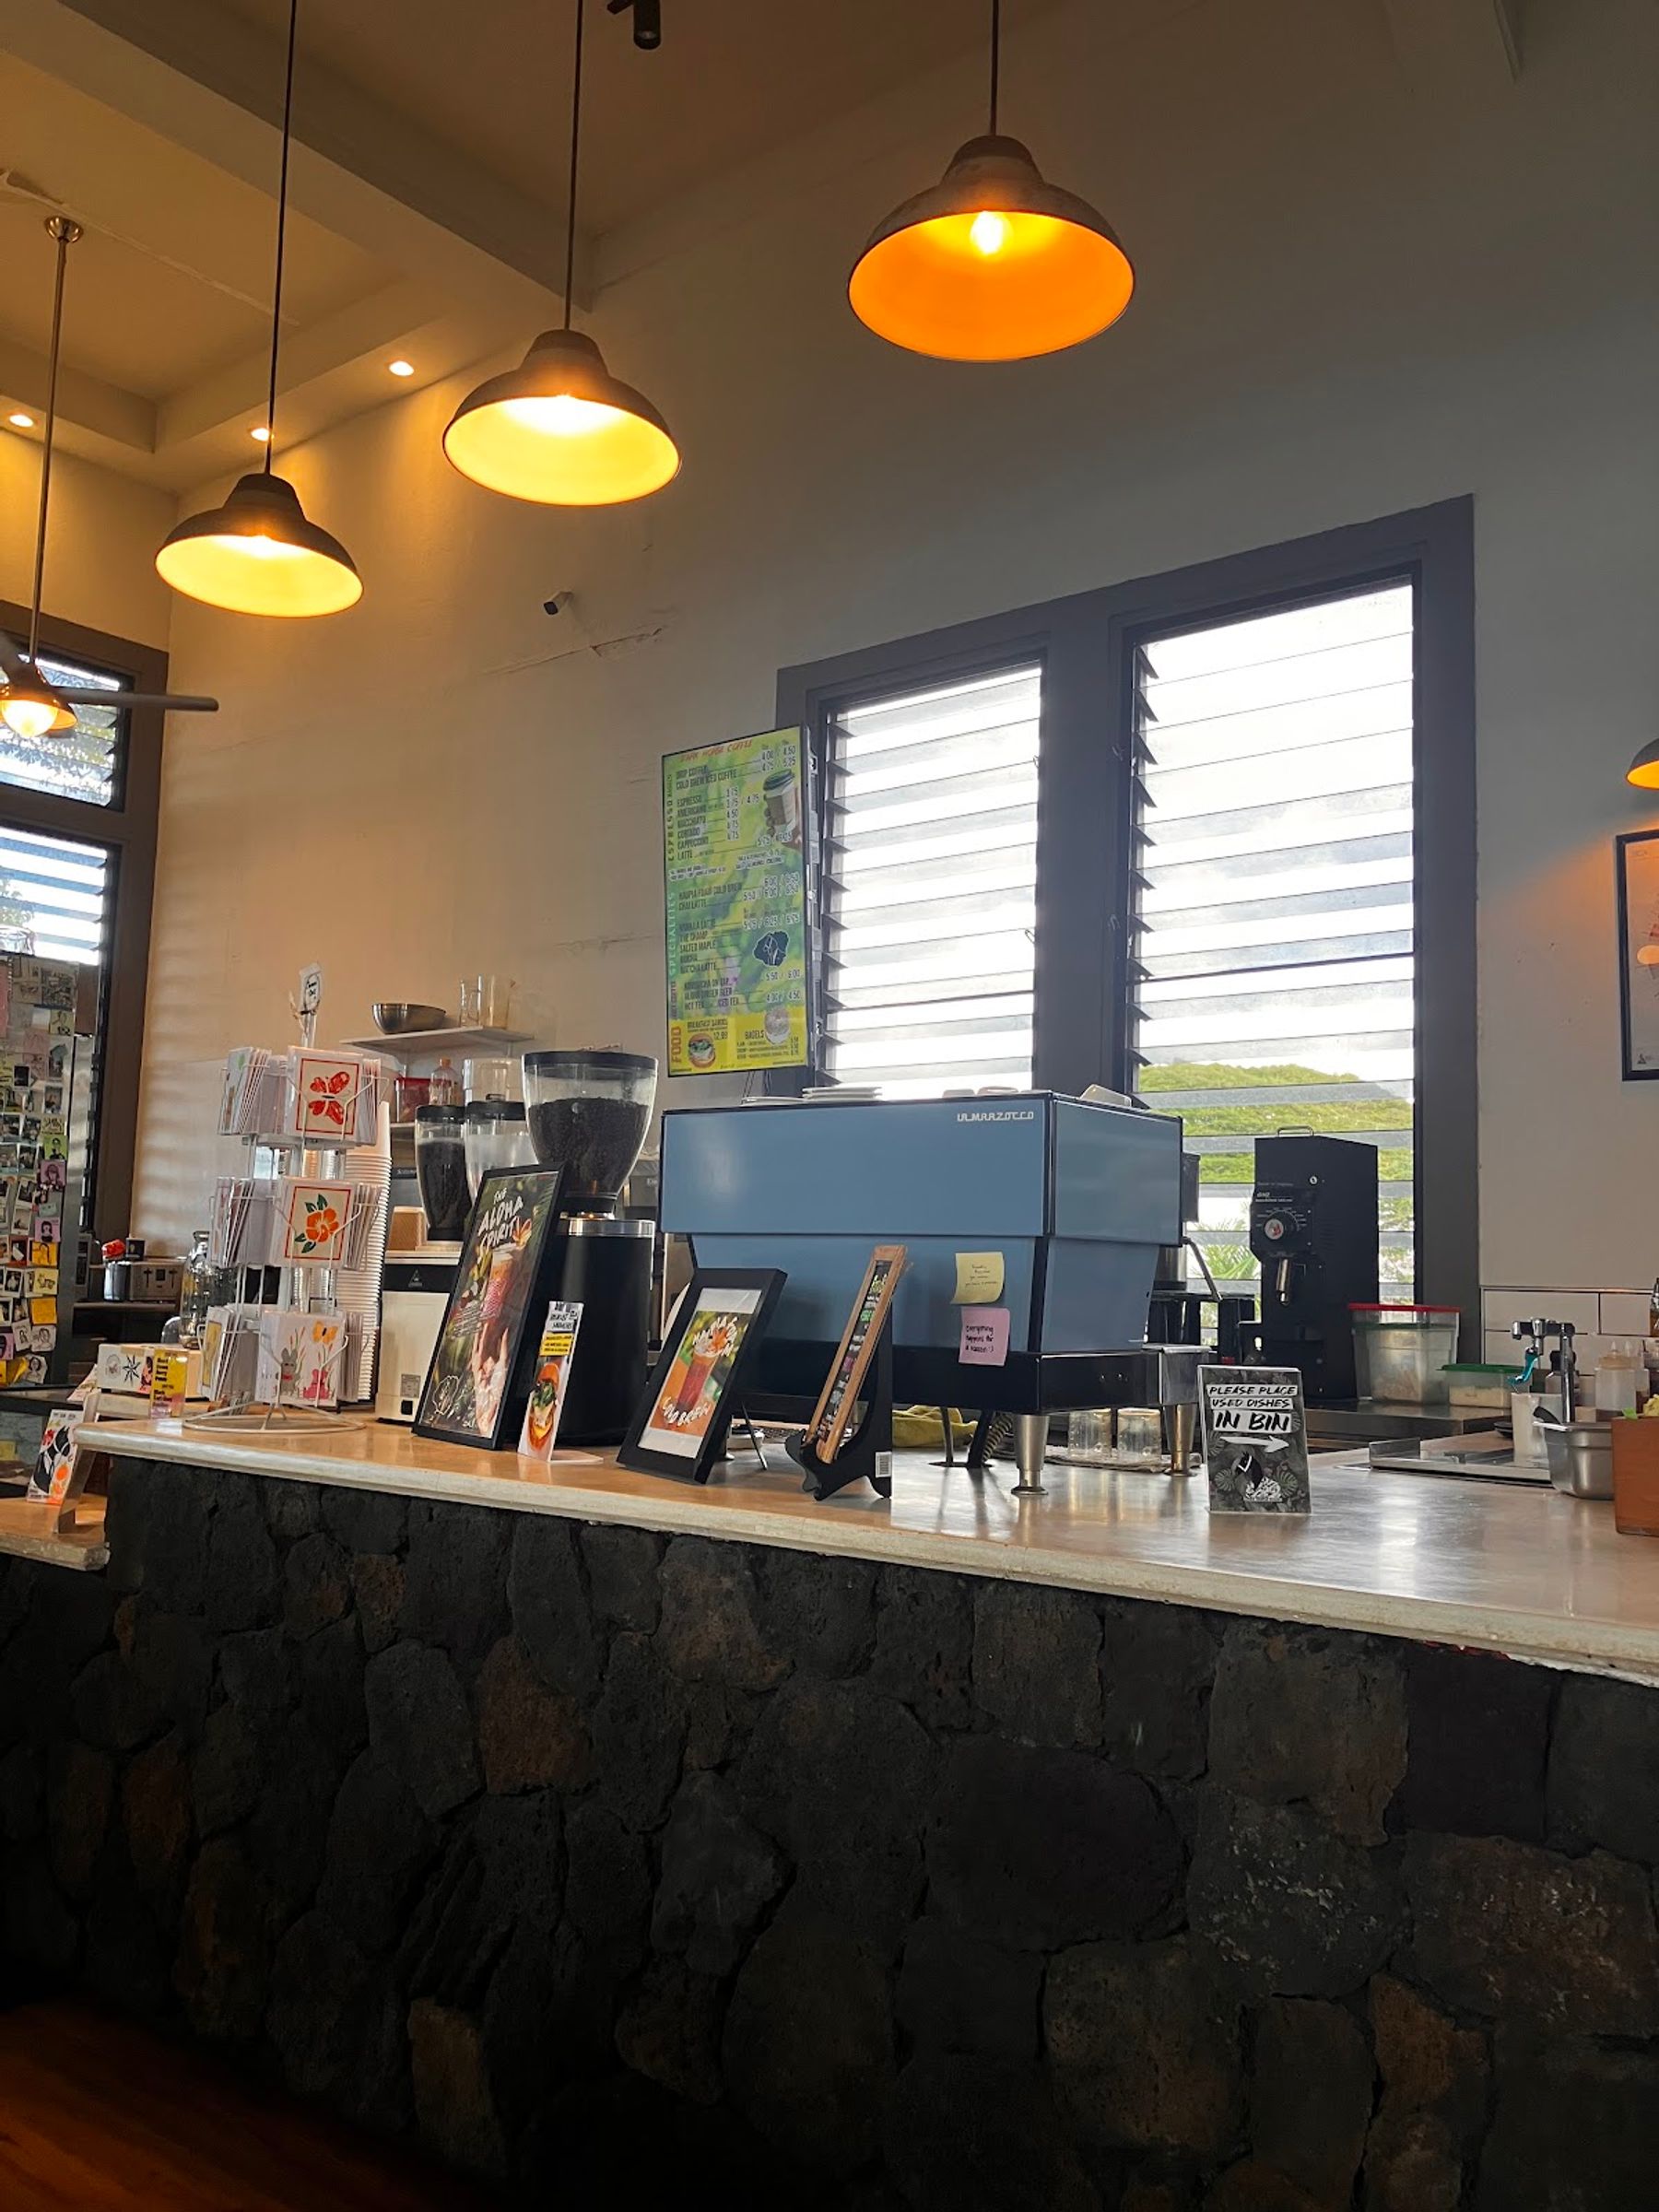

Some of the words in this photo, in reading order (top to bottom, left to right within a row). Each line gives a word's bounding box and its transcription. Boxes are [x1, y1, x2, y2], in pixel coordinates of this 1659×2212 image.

[671, 1026, 682, 1064] FOOD
[477, 1195, 524, 1237] ALOHA
[479, 1216, 518, 1254] SPIRIT
[1209, 1385, 1255, 1395] PLEASE
[1258, 1386, 1297, 1395] PLACE
[1212, 1398, 1243, 1407] USED
[1246, 1398, 1290, 1408] DISHES
[1215, 1410, 1241, 1429] IN
[1248, 1412, 1289, 1431] BIN
